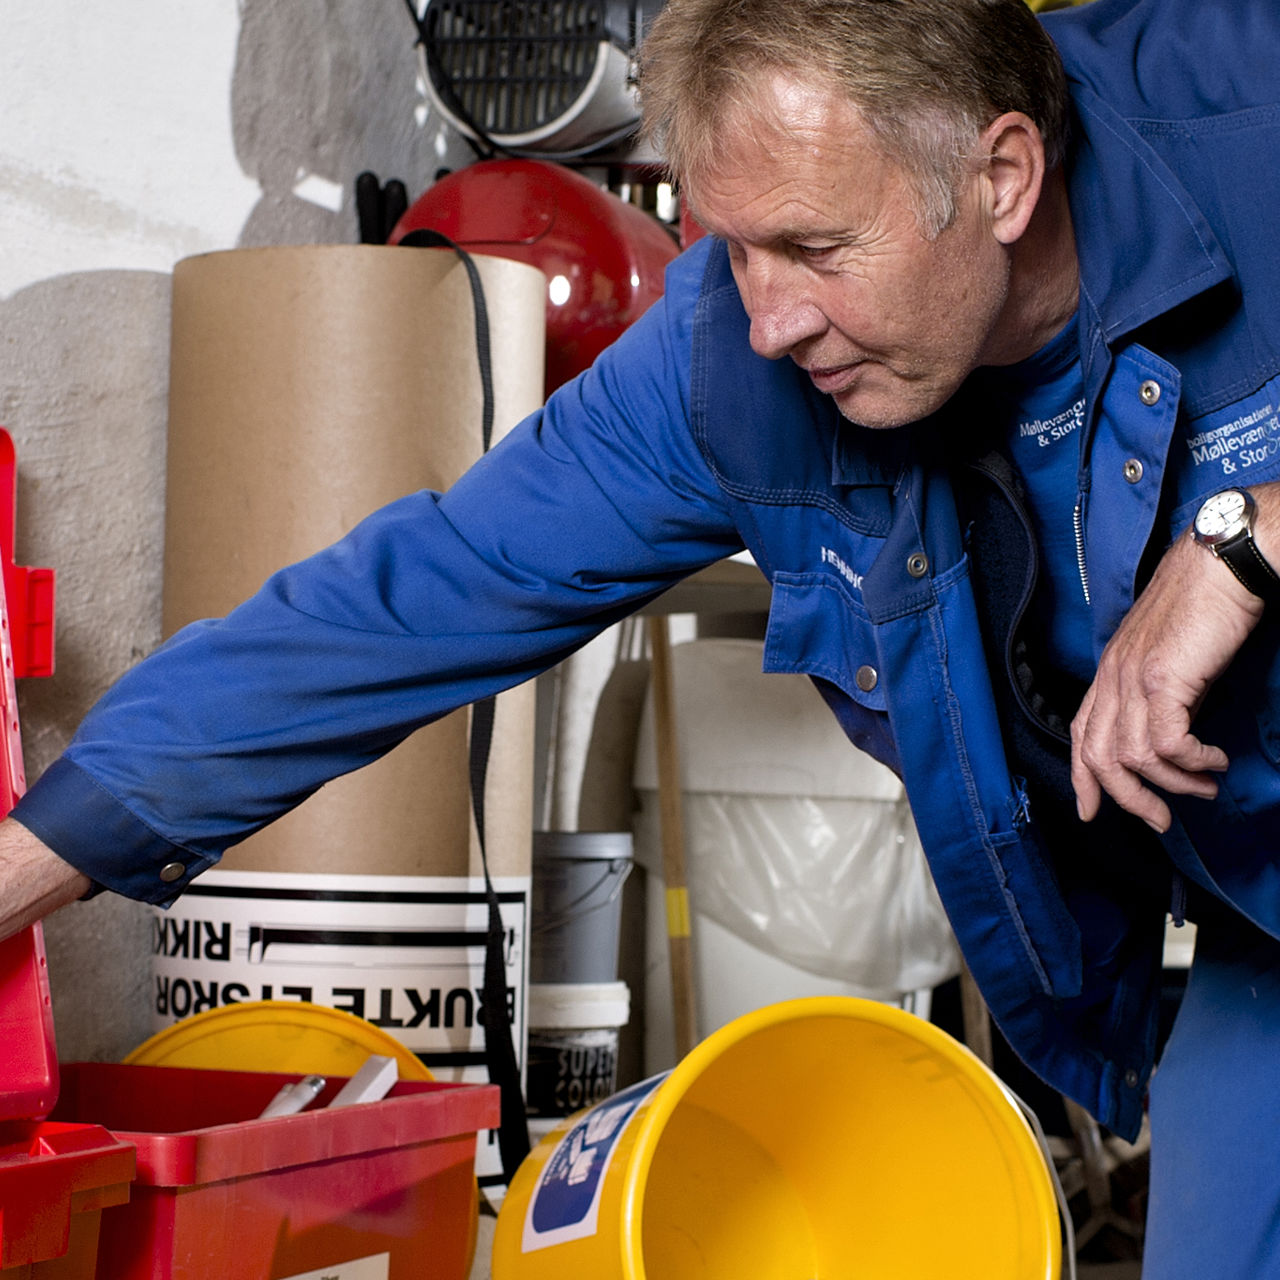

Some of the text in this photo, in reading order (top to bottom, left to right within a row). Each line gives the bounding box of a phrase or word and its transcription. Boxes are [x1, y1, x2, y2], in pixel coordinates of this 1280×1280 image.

[1037, 434, 1050, 447] &
[1221, 457, 1237, 474] &
[153, 917, 231, 961] RIKK
